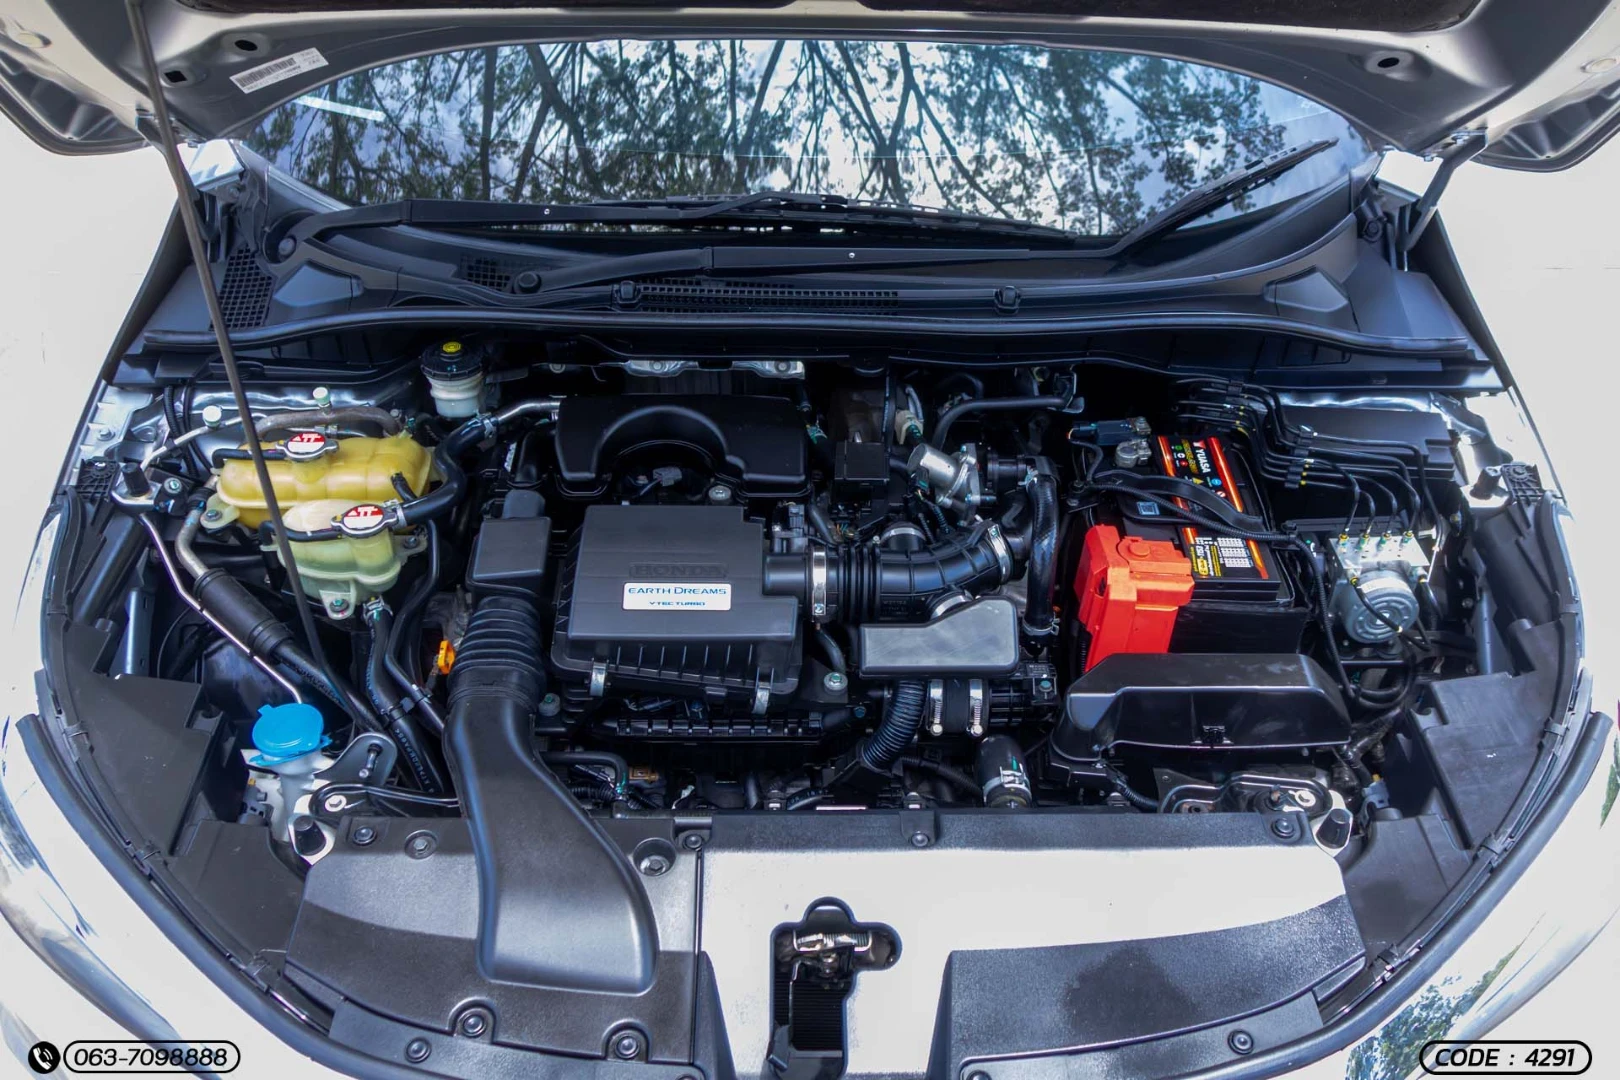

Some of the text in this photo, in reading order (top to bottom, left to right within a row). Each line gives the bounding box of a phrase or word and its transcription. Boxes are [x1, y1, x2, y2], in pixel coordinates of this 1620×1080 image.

[1195, 449, 1211, 473] YUASA
[630, 563, 729, 578] HONDA
[628, 586, 727, 595] EARTH DREAMS
